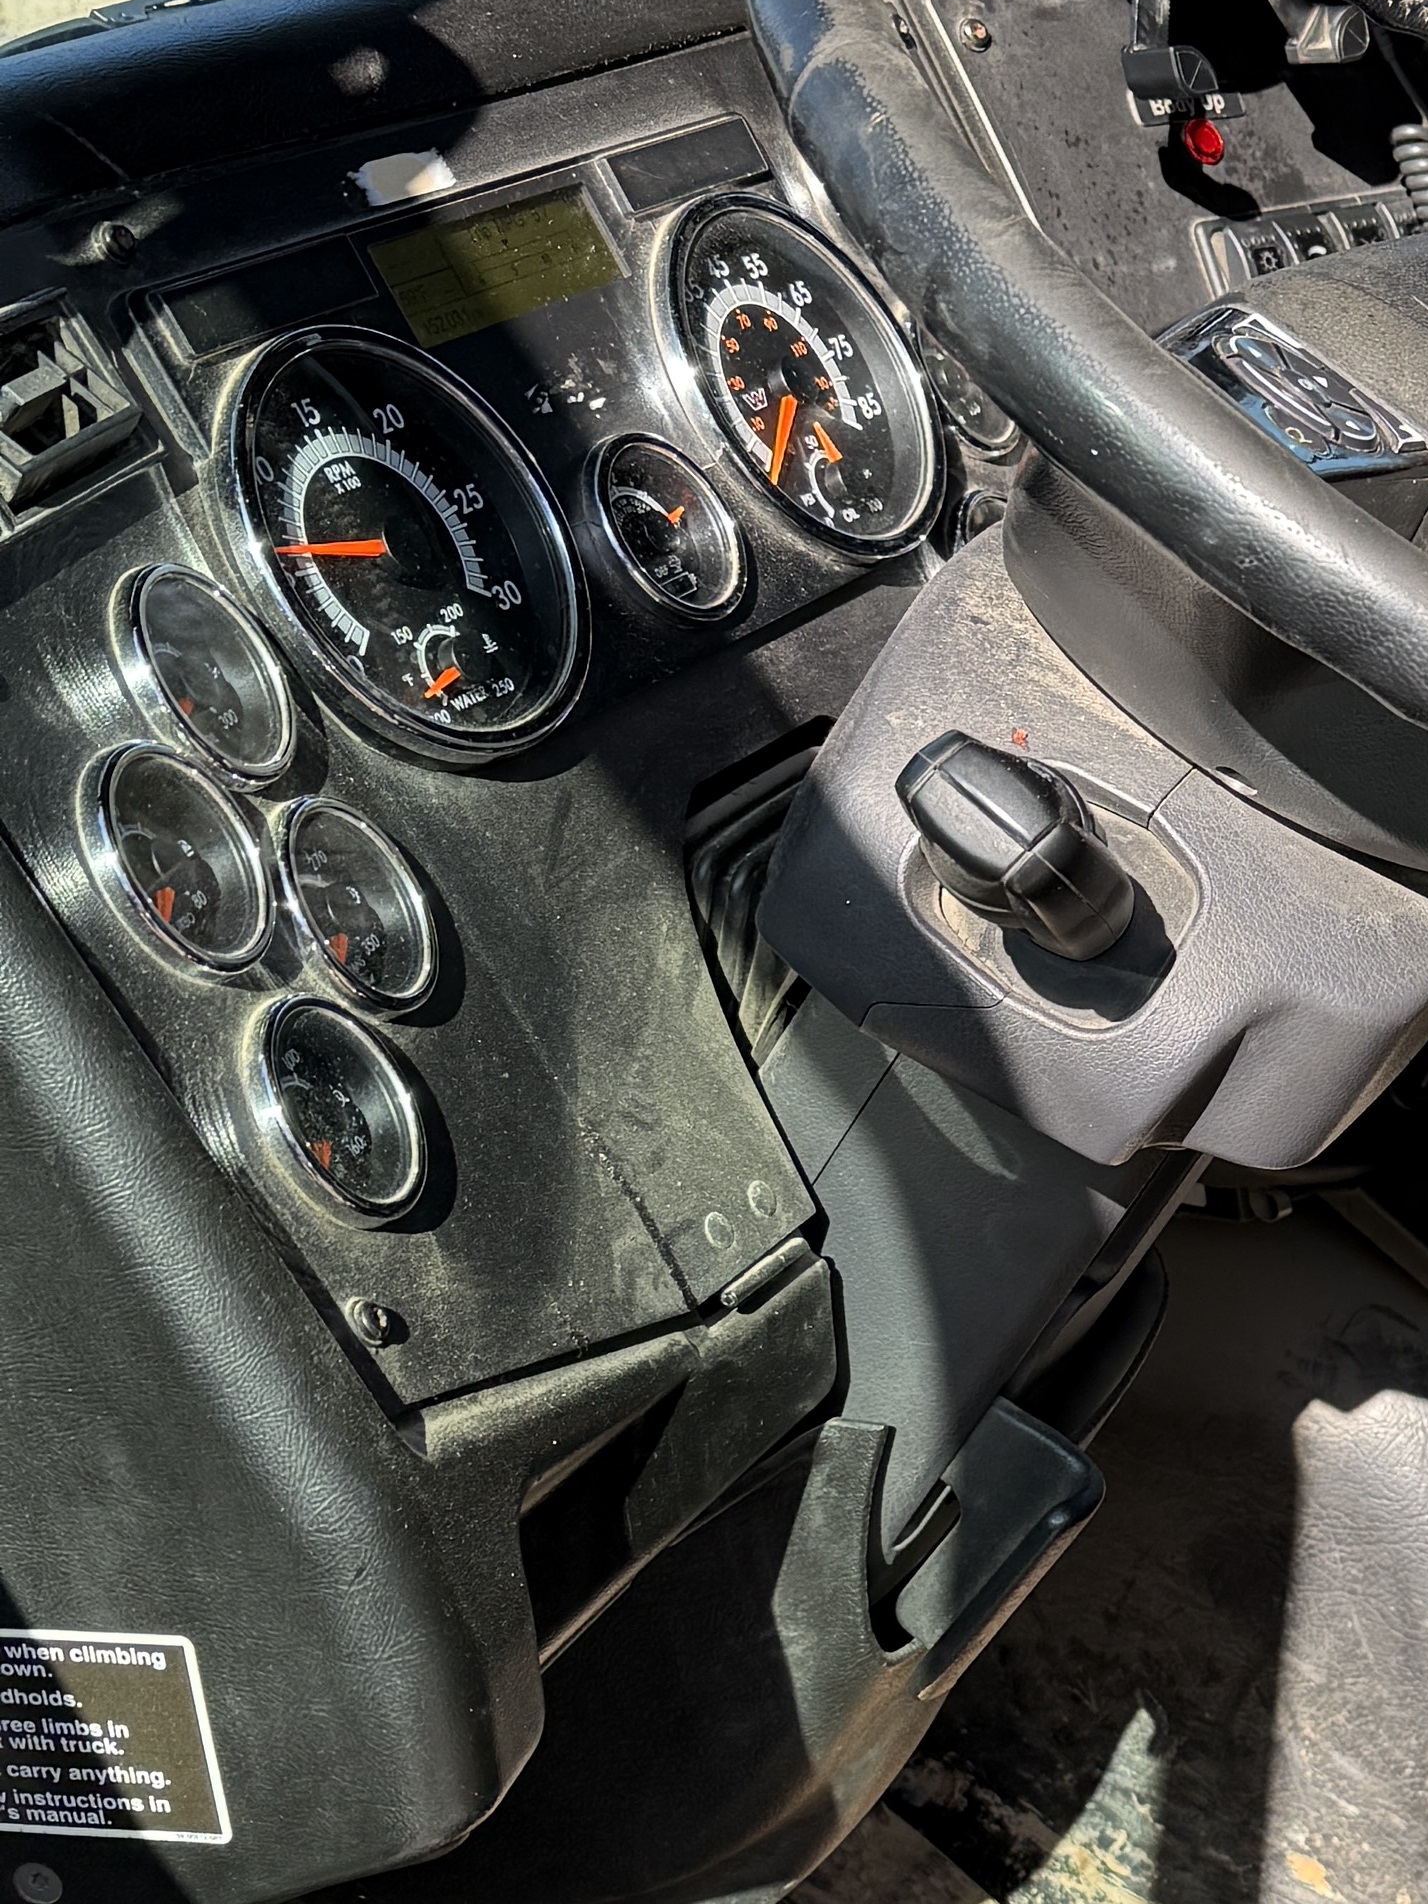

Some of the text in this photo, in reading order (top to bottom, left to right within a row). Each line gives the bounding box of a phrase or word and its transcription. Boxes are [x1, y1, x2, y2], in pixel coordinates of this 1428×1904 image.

[707, 256, 730, 280] 45
[742, 252, 769, 280] 55
[790, 280, 814, 306] 65
[828, 333, 855, 361] 75
[292, 398, 321, 428] 15
[373, 404, 406, 434] 20
[857, 392, 883, 421] 85
[324, 462, 355, 483] RPM
[454, 483, 486, 514] 25
[490, 580, 523, 611] 30
[439, 604, 465, 624] 200
[390, 626, 414, 646] 150
[449, 677, 517, 713] WATER 250
[4, 1643, 167, 1671] when climbing
[42, 1718, 104, 1738] limbs
[107, 1719, 130, 1739] in
[8, 1734, 125, 1756] with truck.
[6, 1764, 172, 1789] carry anything.
[13, 1789, 172, 1813] instructions in
[26, 1809, 113, 1825] manual.
